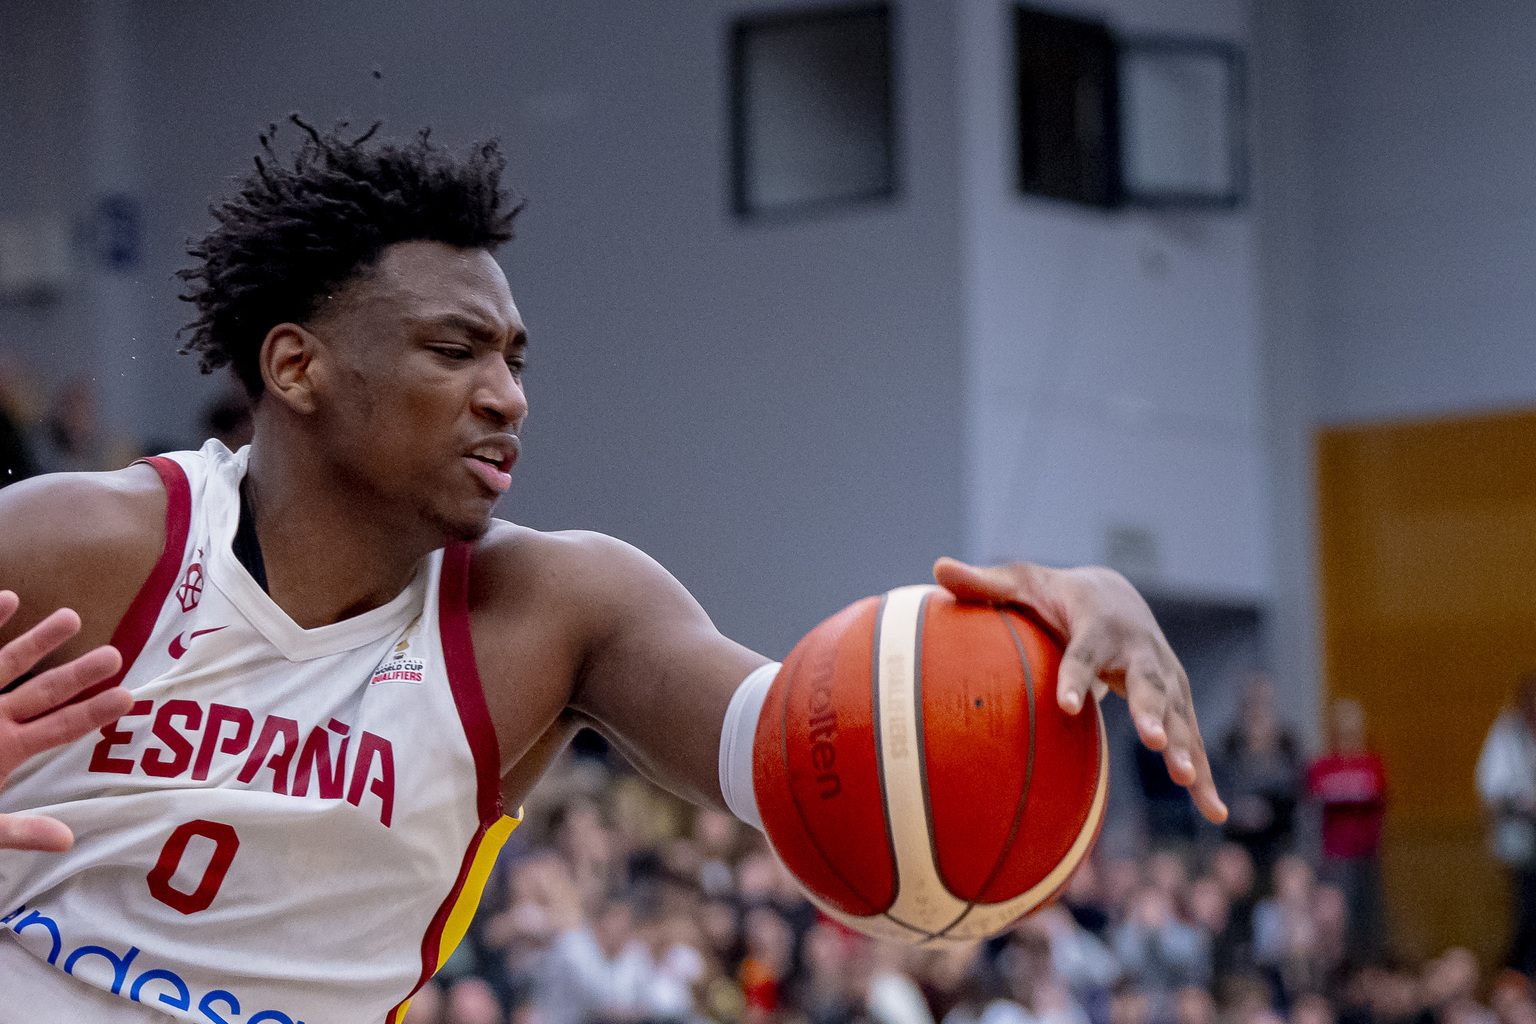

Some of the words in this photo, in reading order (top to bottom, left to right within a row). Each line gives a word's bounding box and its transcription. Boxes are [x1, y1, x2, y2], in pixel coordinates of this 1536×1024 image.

[375, 664, 402, 675] WORLD
[404, 663, 423, 671] CUP
[88, 698, 396, 829] ESPAÑA
[146, 819, 241, 916] 0
